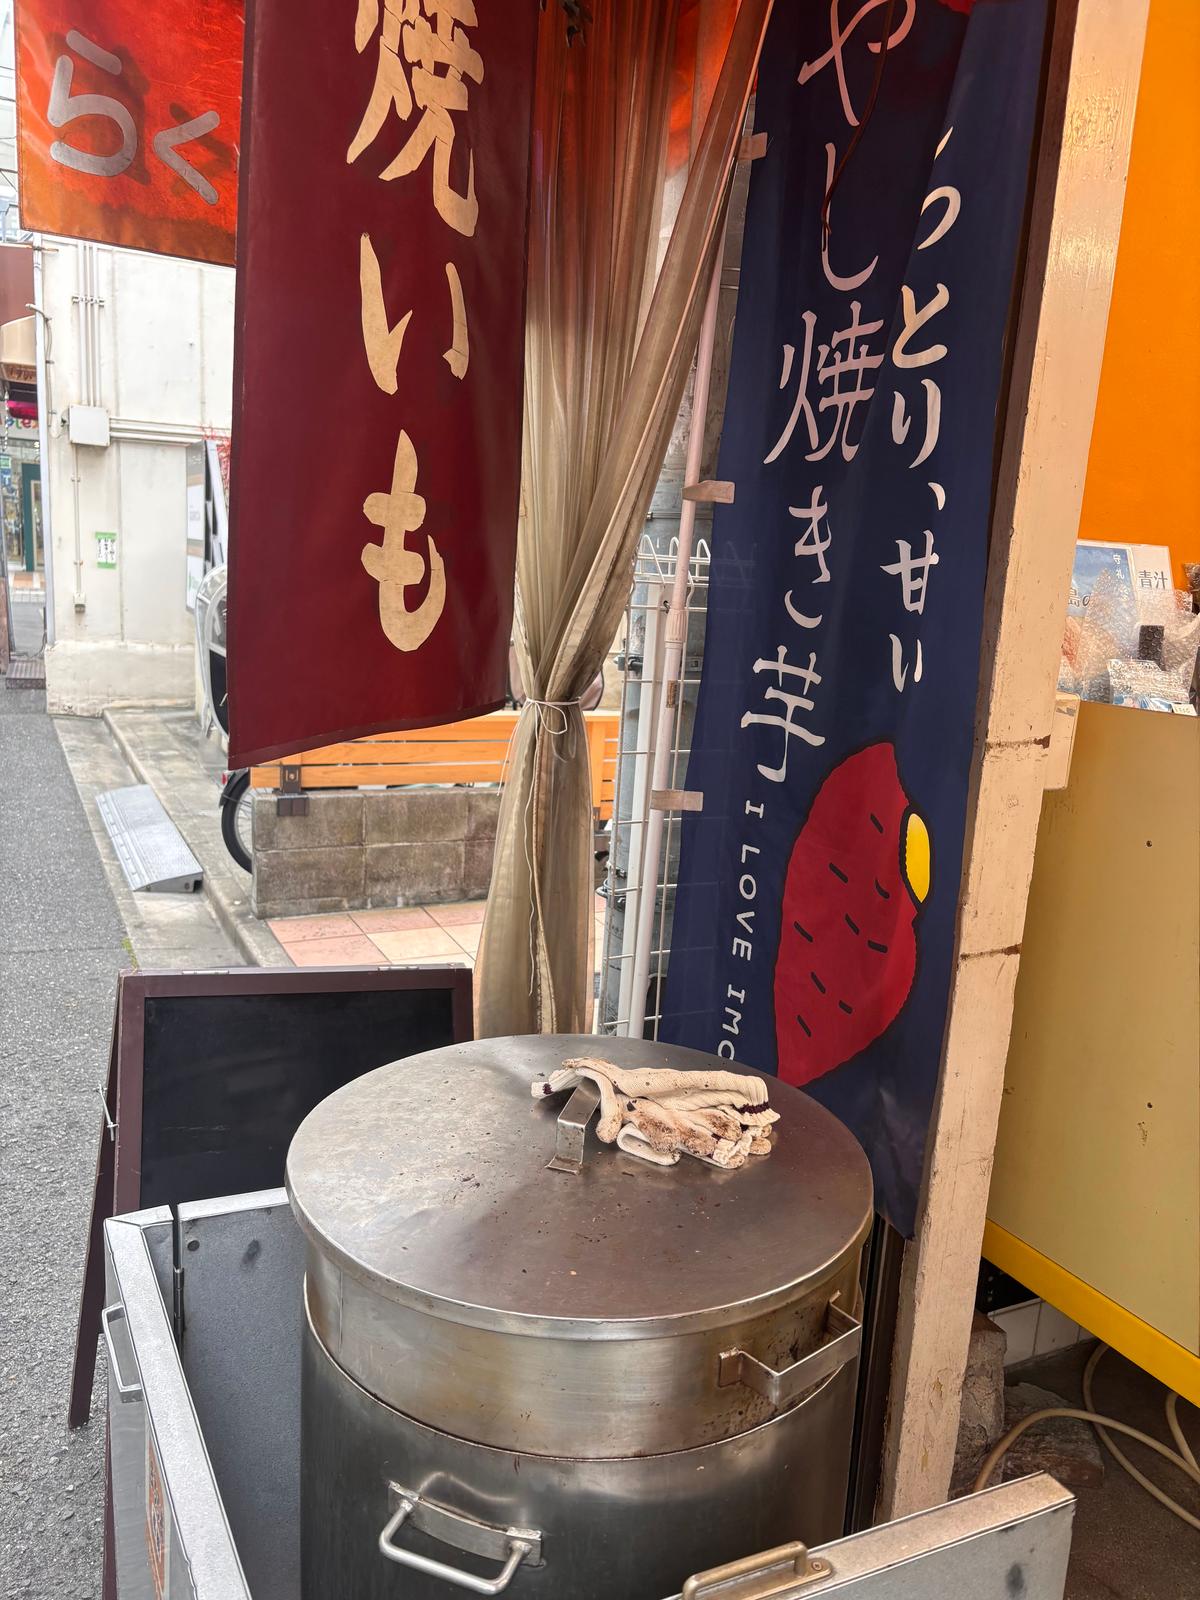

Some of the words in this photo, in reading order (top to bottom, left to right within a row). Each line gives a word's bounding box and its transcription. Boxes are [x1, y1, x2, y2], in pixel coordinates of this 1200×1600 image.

[47, 29, 220, 205] らく
[346, 0, 485, 652] 焼いも
[880, 126, 962, 693] っとり、甘い
[1138, 569, 1168, 590] 青汁
[744, 799, 765, 819] I
[732, 843, 761, 961] LOVE
